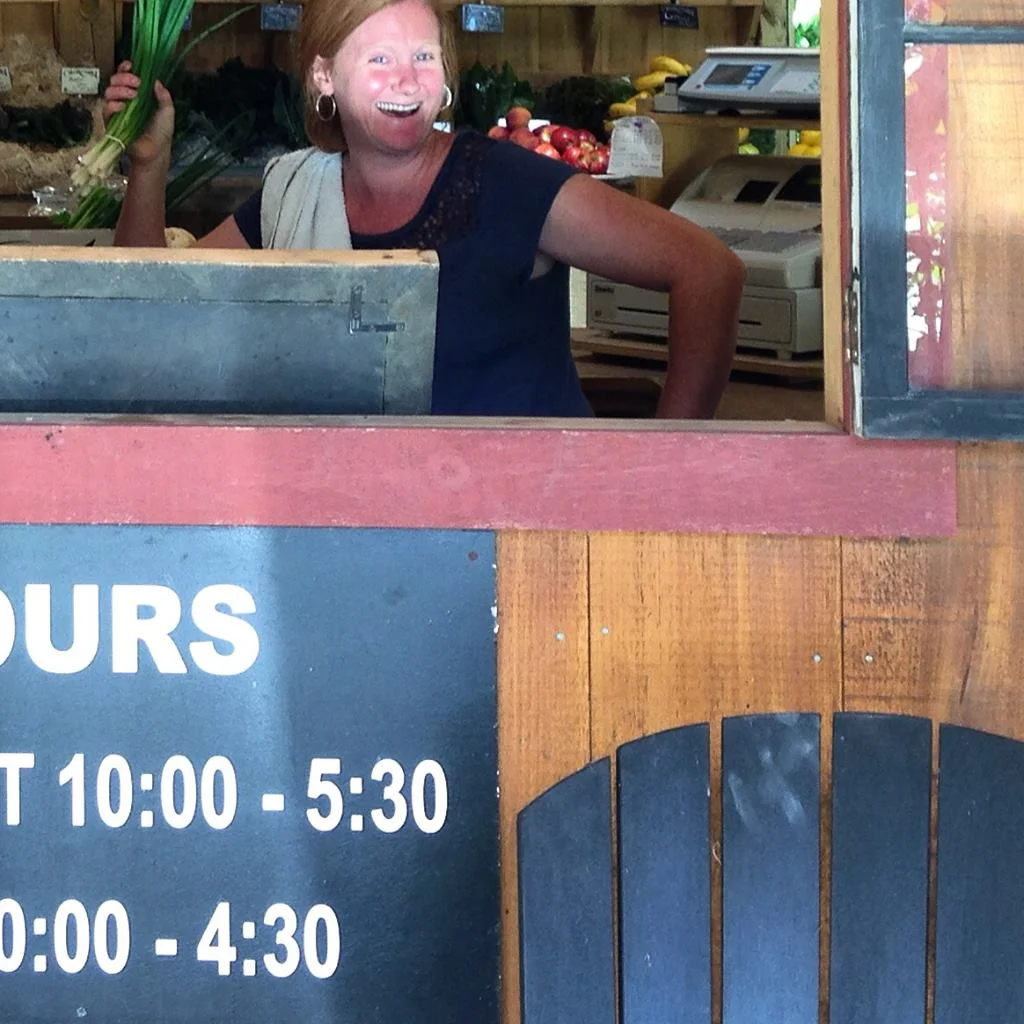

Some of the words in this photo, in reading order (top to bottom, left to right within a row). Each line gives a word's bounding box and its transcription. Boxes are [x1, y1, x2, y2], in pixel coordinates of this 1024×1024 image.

[58, 753, 238, 831] 10:00
[260, 793, 286, 812] -
[305, 757, 449, 835] 5:30
[154, 938, 179, 957] -
[195, 901, 341, 980] 4:30
